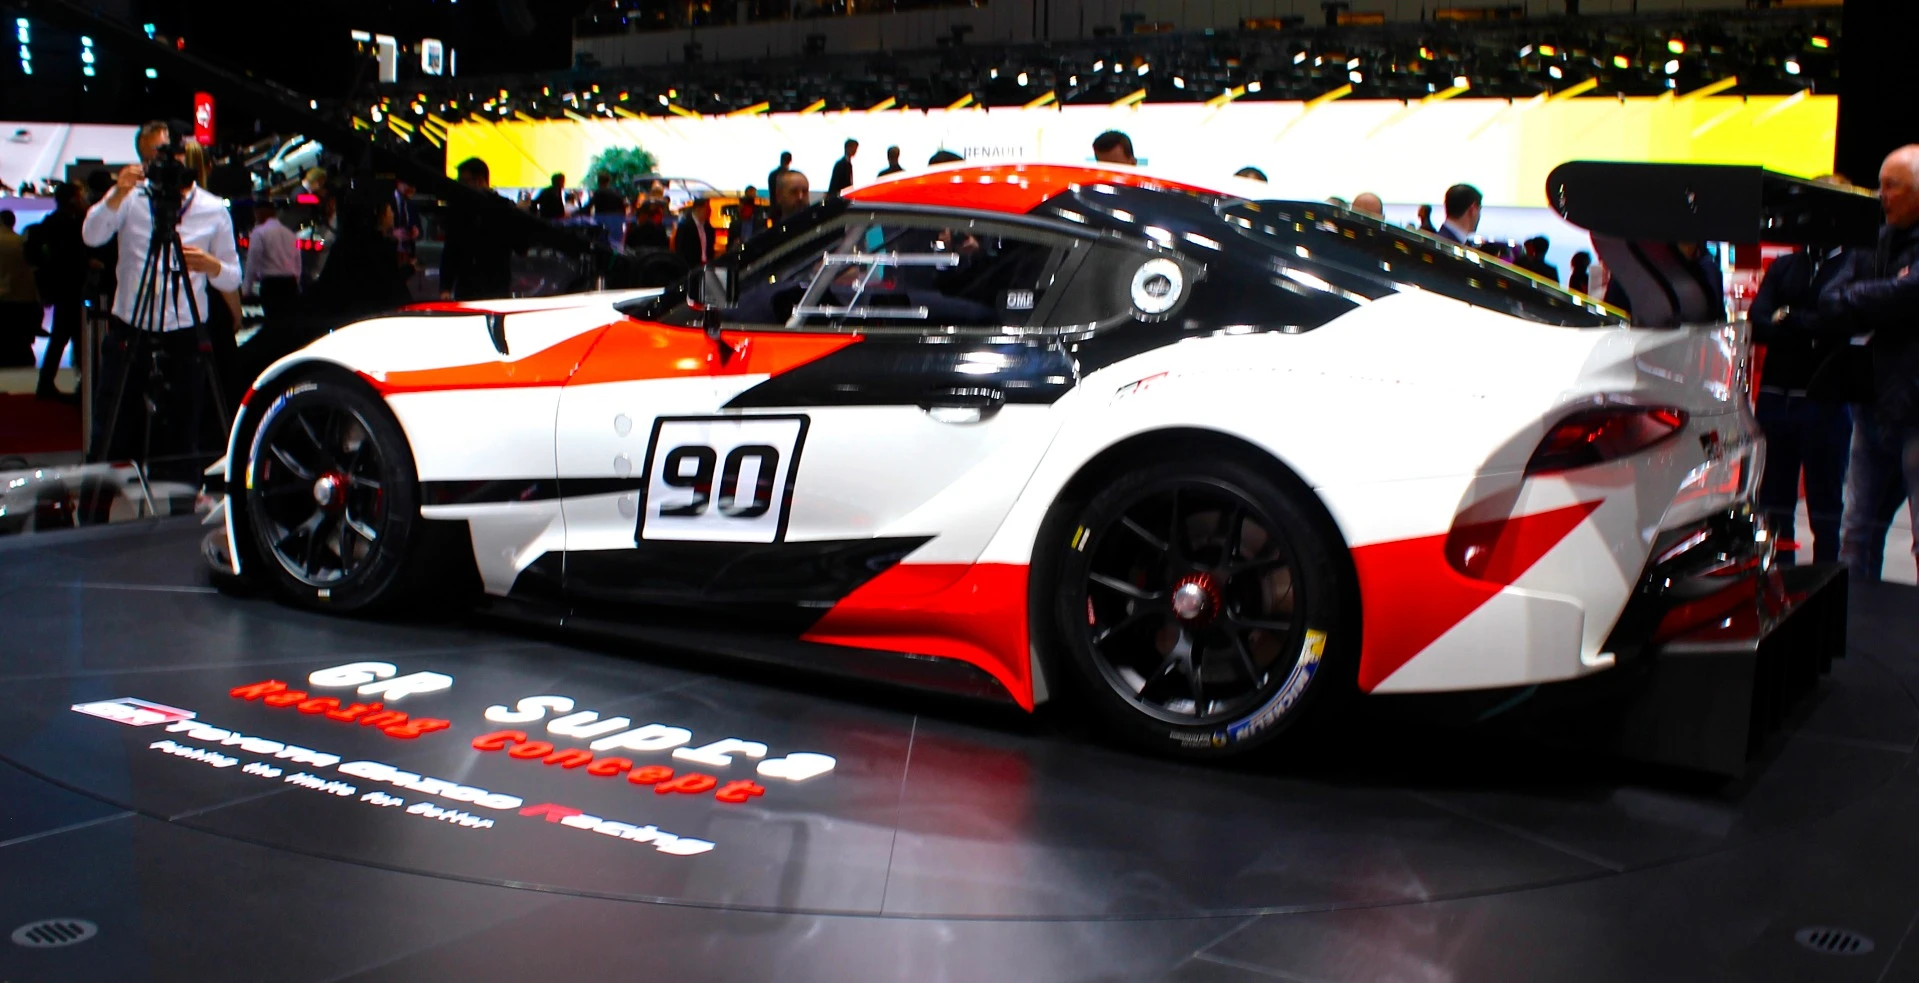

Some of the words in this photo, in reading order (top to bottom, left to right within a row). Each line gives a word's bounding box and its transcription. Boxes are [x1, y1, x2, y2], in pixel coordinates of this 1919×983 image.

[964, 146, 1022, 158] RENAULT
[659, 444, 780, 518] 90
[229, 679, 451, 739] Racing
[471, 729, 765, 803] Concept
[308, 661, 453, 700] GR
[484, 695, 837, 781] Supra
[1235, 667, 1311, 743] MICHELIN
[165, 719, 341, 768] TOYOTA
